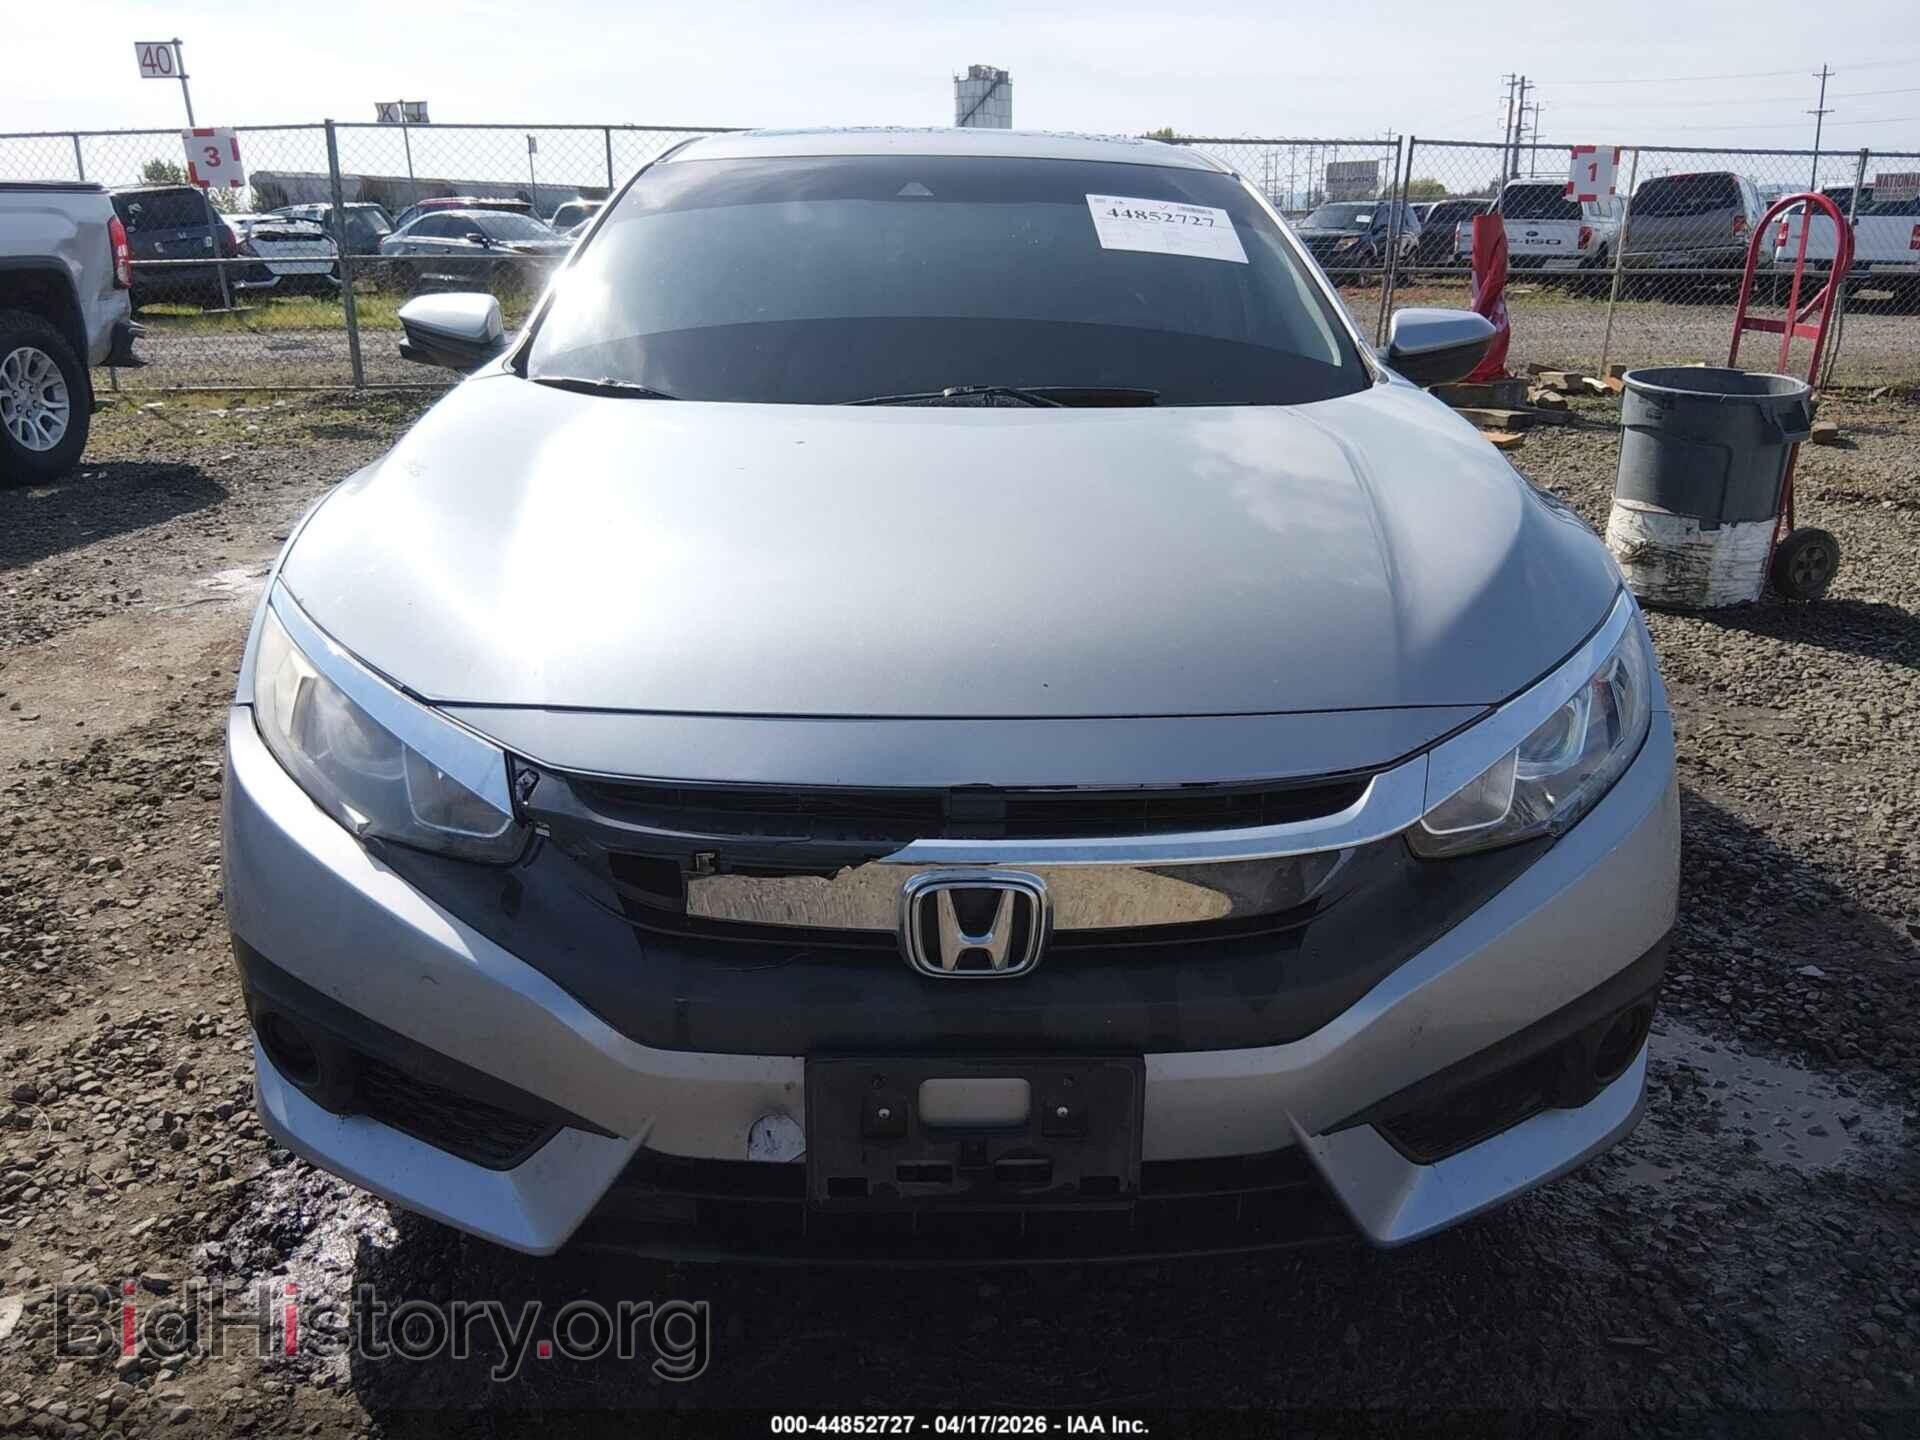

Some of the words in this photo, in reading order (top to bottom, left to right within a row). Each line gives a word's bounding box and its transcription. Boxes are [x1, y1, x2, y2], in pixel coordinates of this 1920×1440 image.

[141, 45, 172, 75] 40
[379, 104, 394, 121] K
[203, 146, 222, 167] 3
[1587, 162, 1599, 182] 1
[1106, 207, 1216, 228] 44852727
